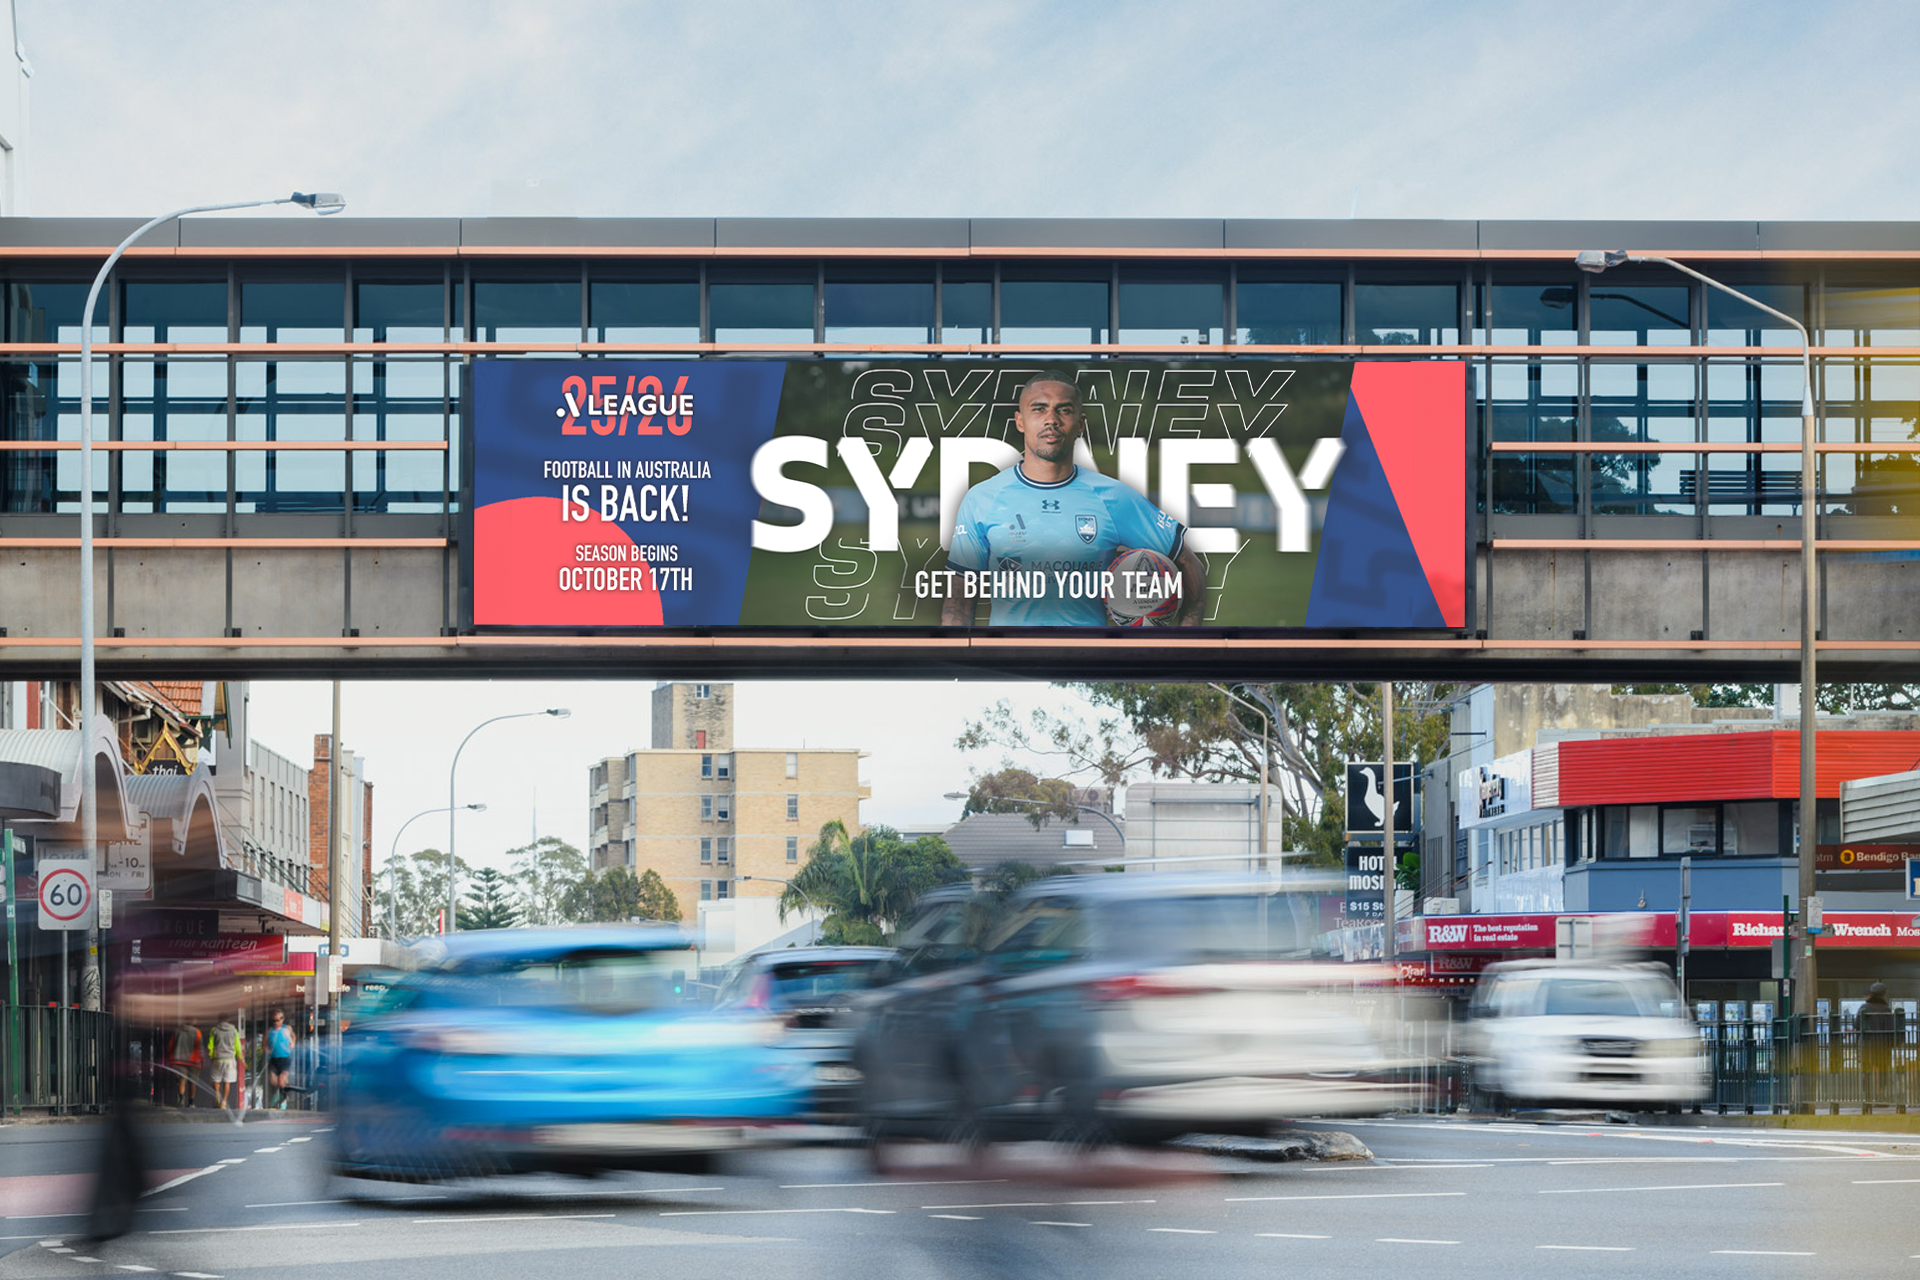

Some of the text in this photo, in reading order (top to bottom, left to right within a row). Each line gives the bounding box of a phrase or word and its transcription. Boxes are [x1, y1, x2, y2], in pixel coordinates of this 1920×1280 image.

[543, 460, 712, 479] FOOTBALL IN AUSTRALIA
[561, 484, 690, 522] IS BACK!
[575, 544, 679, 563] SEASON BEGINS
[558, 567, 694, 591] OCTOBER 17TH
[915, 570, 1183, 599] GET BEHIND YOUR TEAM
[152, 764, 178, 776] thai
[1358, 855, 1400, 871] HOTL
[1856, 851, 1899, 863] Bendigo
[50, 883, 82, 906] 60
[1349, 901, 1370, 911] $15
[1428, 924, 1468, 943] R&W
[1473, 924, 1487, 932] The
[1503, 923, 1539, 934] reputation
[1497, 933, 1518, 941] estate
[1832, 923, 1892, 937] Wrench
